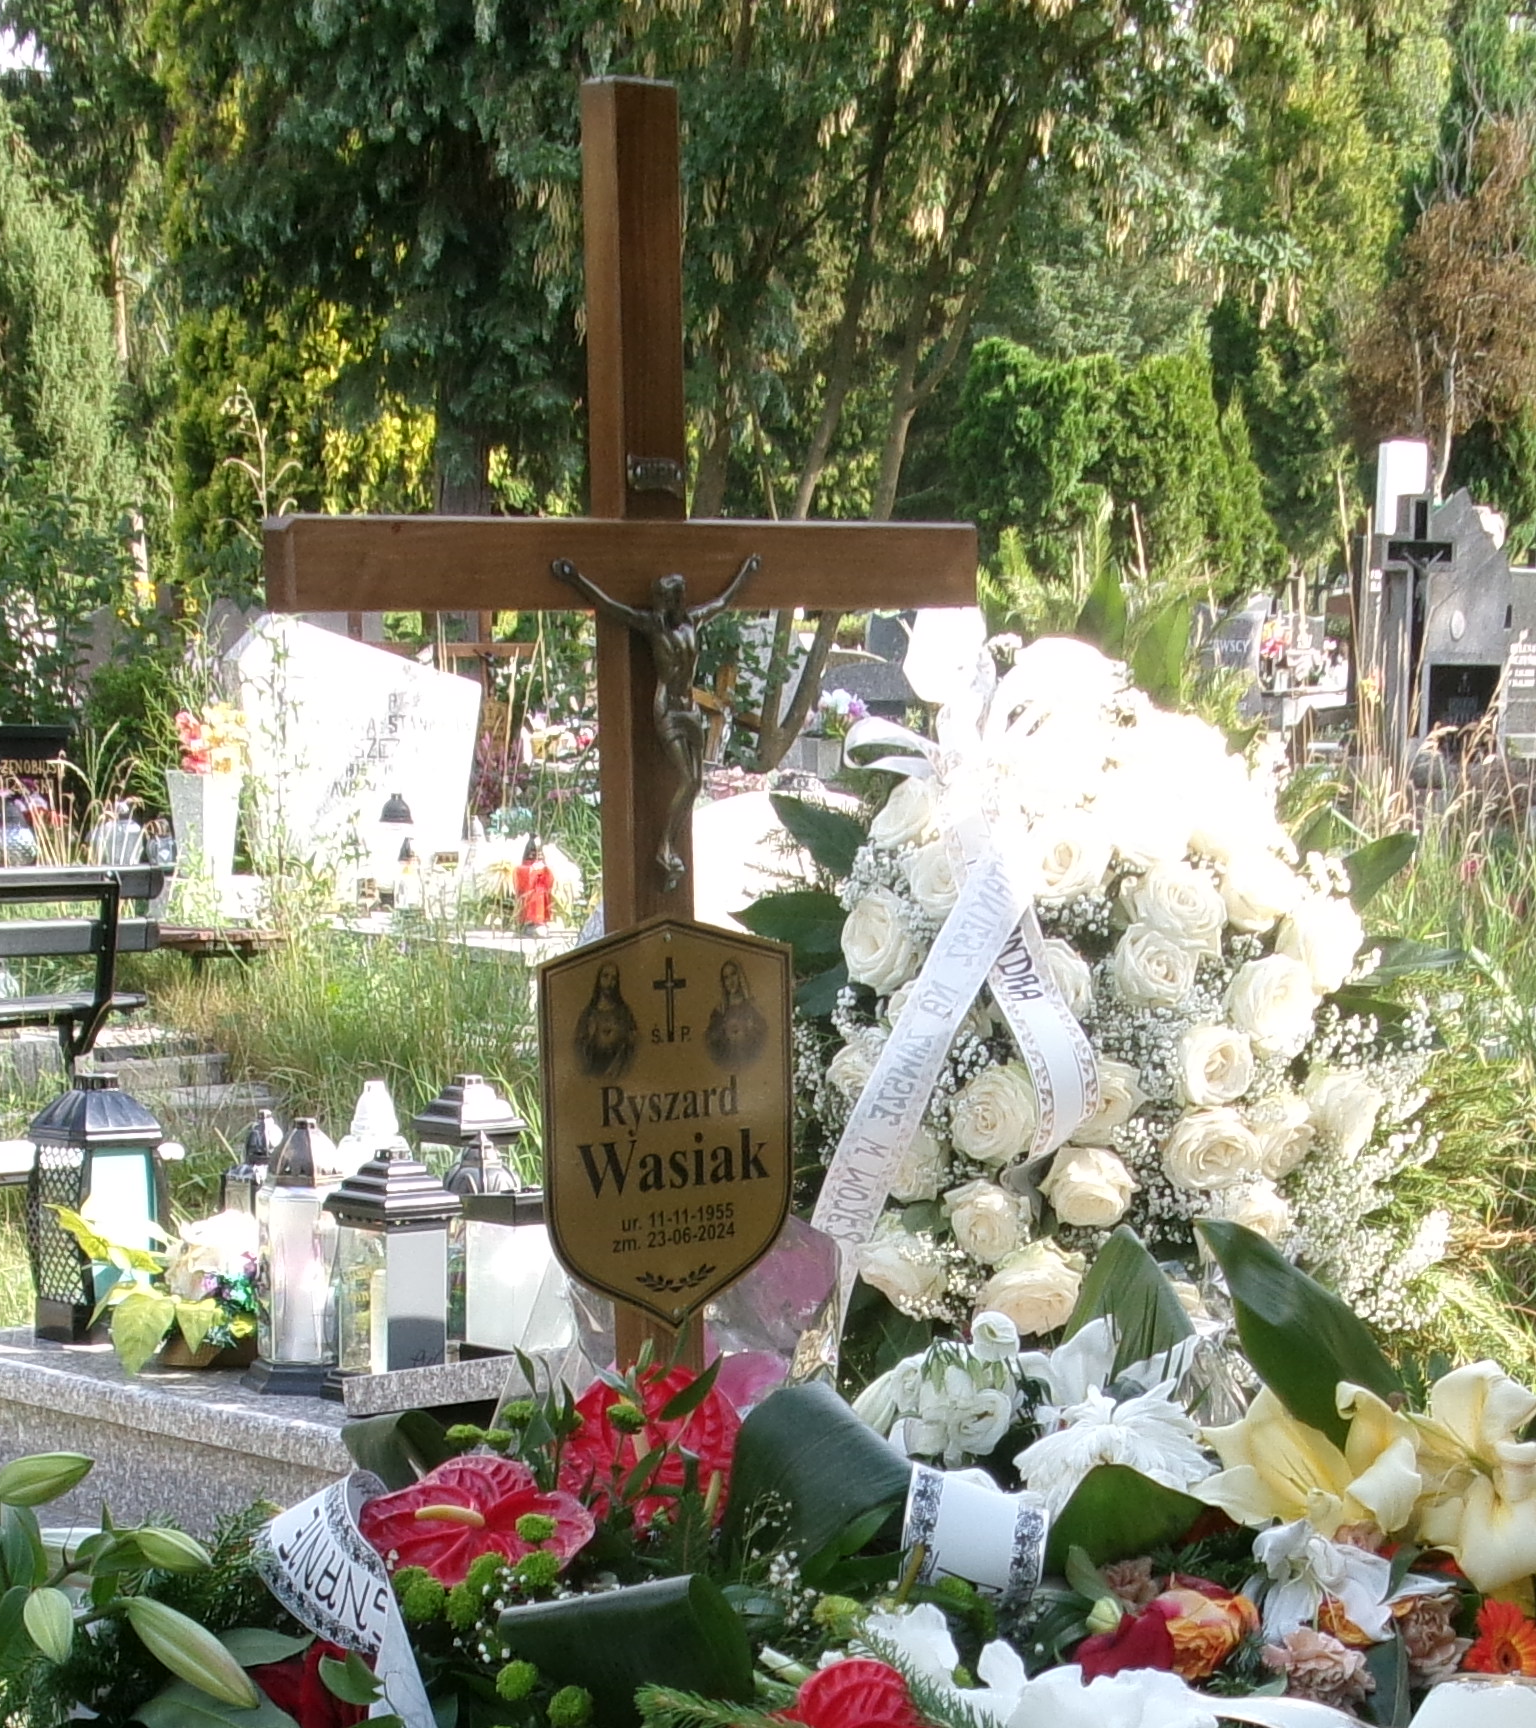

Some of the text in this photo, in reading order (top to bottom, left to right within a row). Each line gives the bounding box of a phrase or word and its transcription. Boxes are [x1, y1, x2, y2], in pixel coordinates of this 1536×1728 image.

[996, 928, 1045, 1004] NDRA
[600, 1075, 739, 1137] Ryszard
[578, 1128, 771, 1199] Wasiak
[612, 1222, 736, 1254] zm. 23-06-2024
[620, 1202, 735, 1233] ur. 11-11-1955
